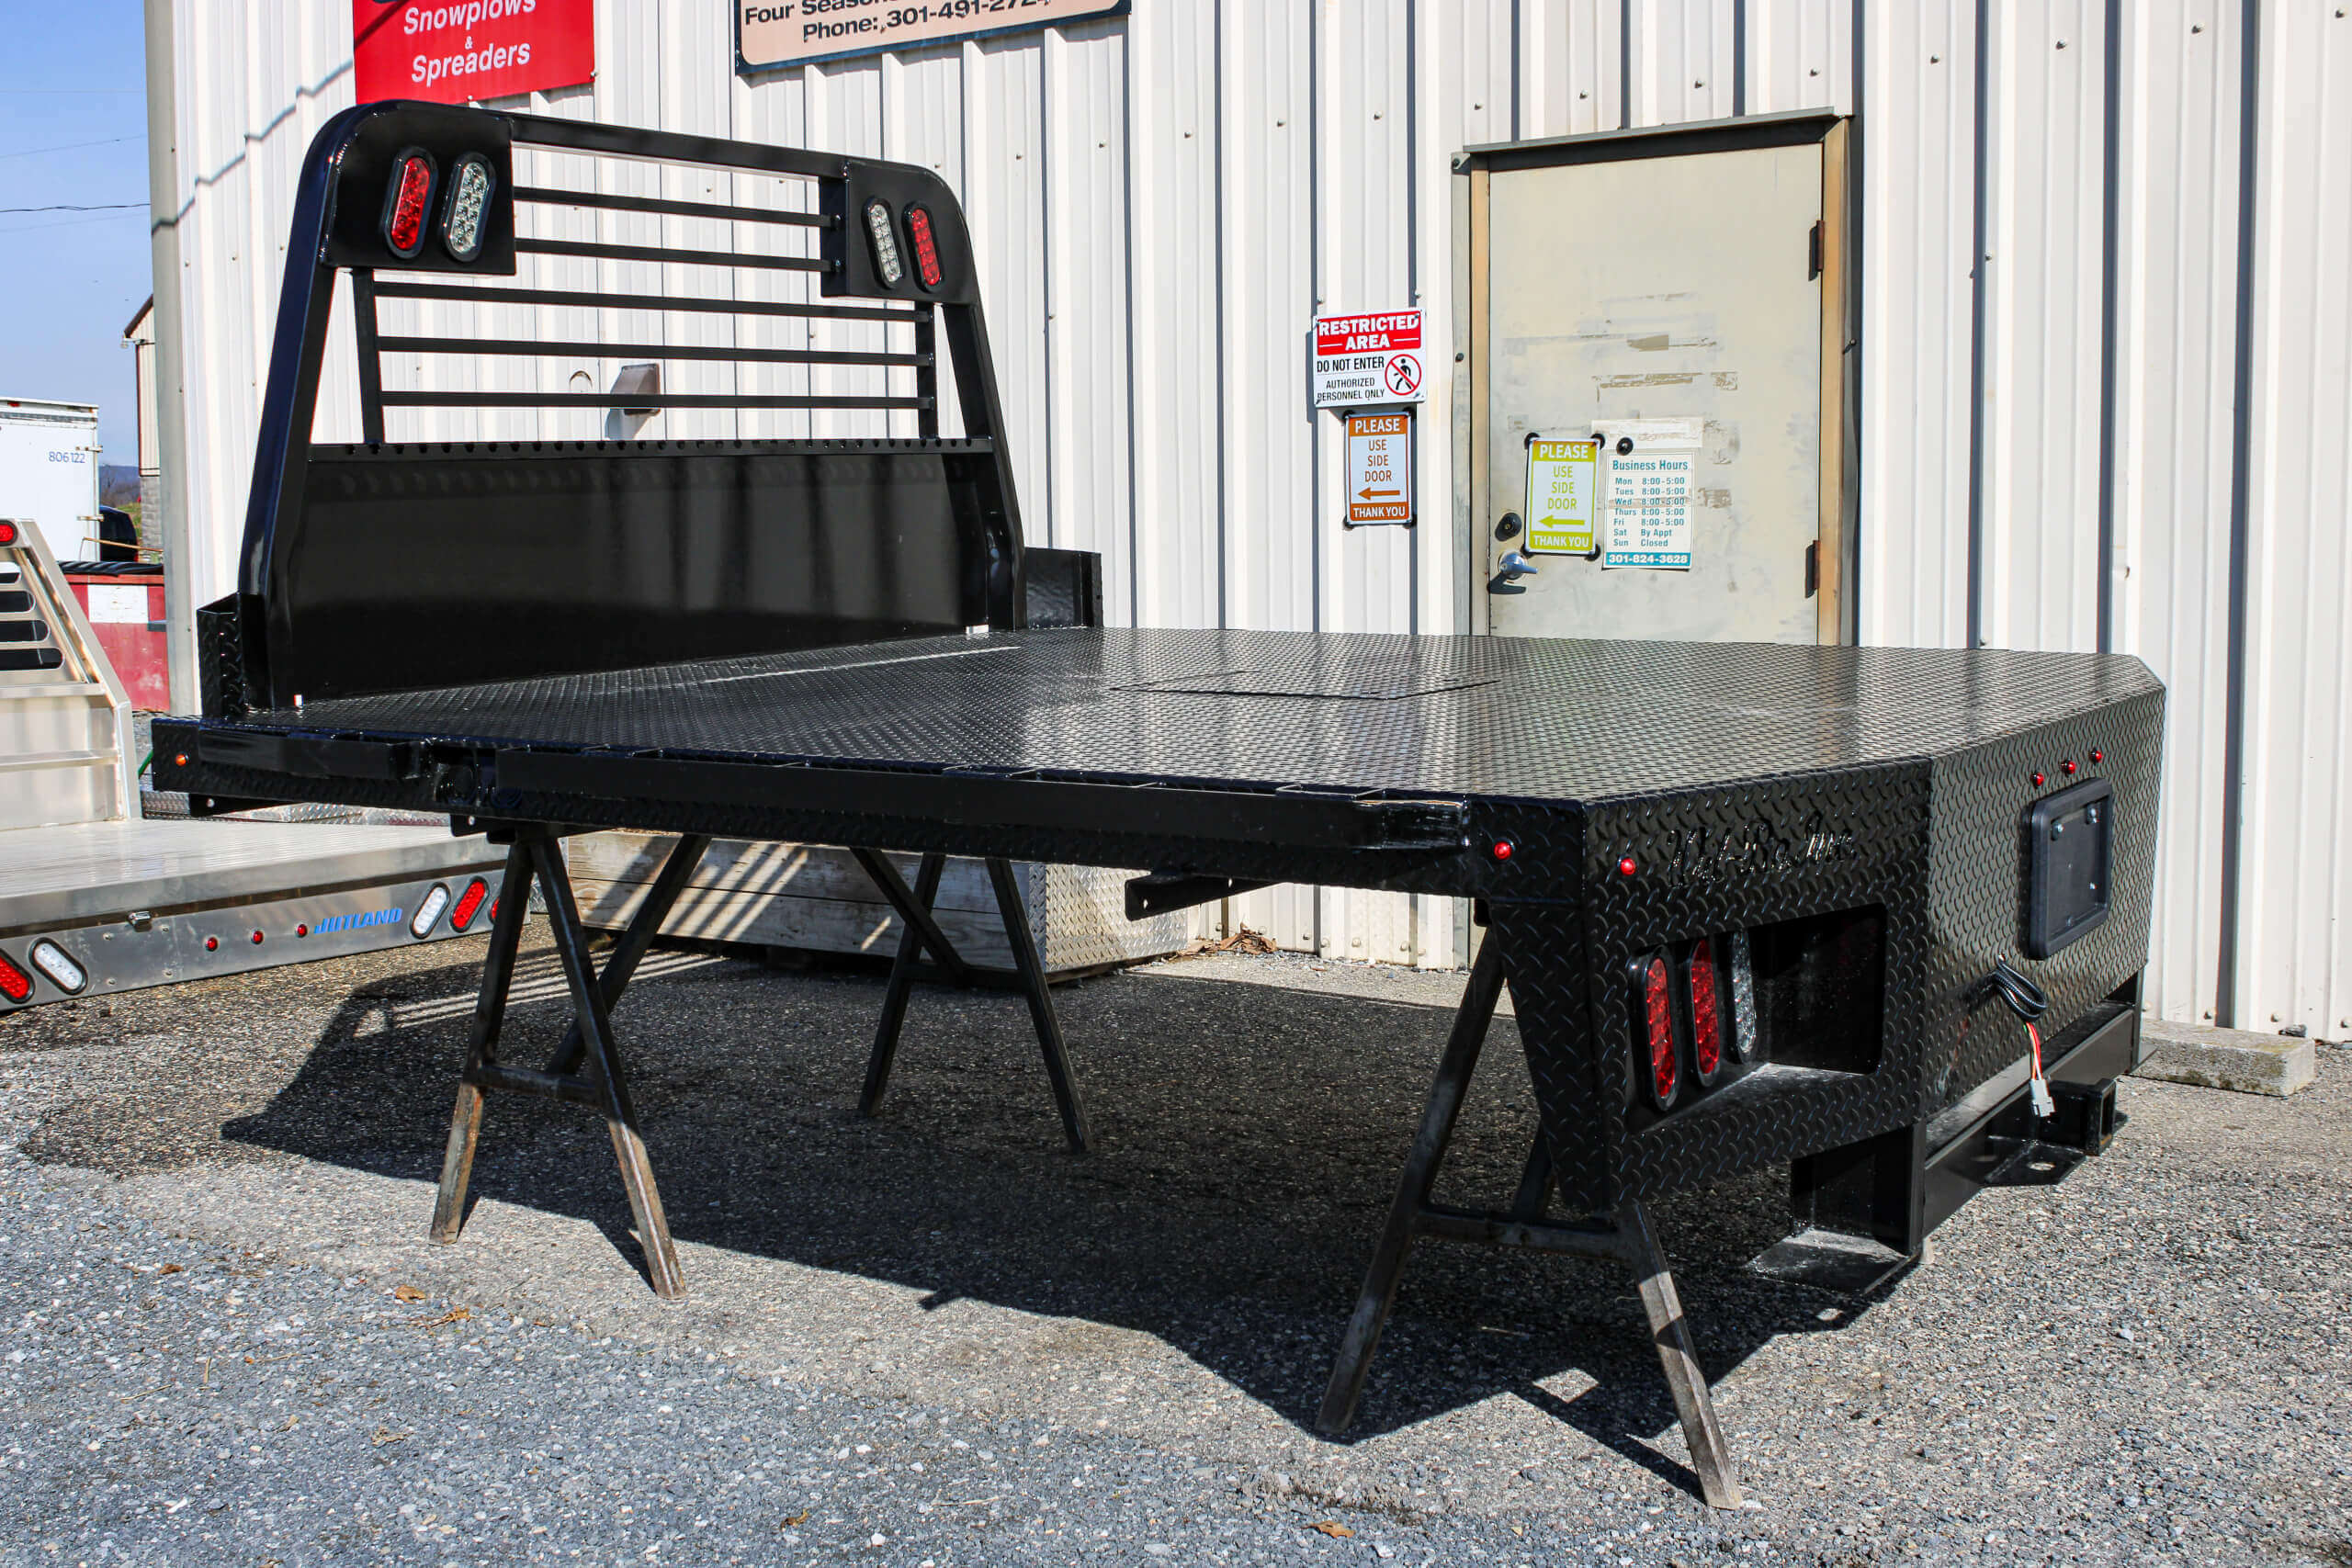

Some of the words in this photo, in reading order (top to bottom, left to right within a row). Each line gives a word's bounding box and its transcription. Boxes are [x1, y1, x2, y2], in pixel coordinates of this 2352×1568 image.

[403, 0, 537, 34] Snowplows
[745, 4, 795, 25] Four
[801, 0, 898, 16] Seas
[803, 17, 878, 43] Phone:
[464, 36, 473, 50] &
[411, 42, 531, 87] Spreaders
[1318, 313, 1419, 336] RESTRICTED
[1345, 333, 1390, 351] AREA
[1317, 360, 1329, 373] DO
[1332, 359, 1351, 371] NOT
[1353, 356, 1385, 370] ENTER
[1326, 378, 1375, 389] AUTHORIZED
[1317, 391, 1363, 401] PERSONNEL
[1364, 389, 1385, 400] ONLY
[1355, 418, 1400, 434] PLEASE
[1368, 439, 1387, 451] USE
[1540, 445, 1589, 458] PLEASE
[1367, 455, 1388, 467] SIDE
[1612, 459, 1657, 471] Business
[1659, 460, 1688, 470] Hours
[1364, 469, 1392, 483] DOOR
[1553, 466, 1573, 479] USE
[1552, 481, 1574, 494] SIDE
[1615, 477, 1633, 485] Mon
[1547, 497, 1577, 511] DOOR
[1352, 508, 1385, 518] THANK
[1385, 506, 1406, 517] YOU
[1615, 508, 1637, 516] Thurs
[1614, 518, 1624, 526] Fri
[1614, 528, 1627, 536] Sat
[1641, 528, 1651, 537] By
[1654, 528, 1672, 537] Appt
[1533, 536, 1567, 547] THANK
[1568, 536, 1589, 547] YOU
[1613, 538, 1629, 547] Sun
[1640, 538, 1668, 547] Closed
